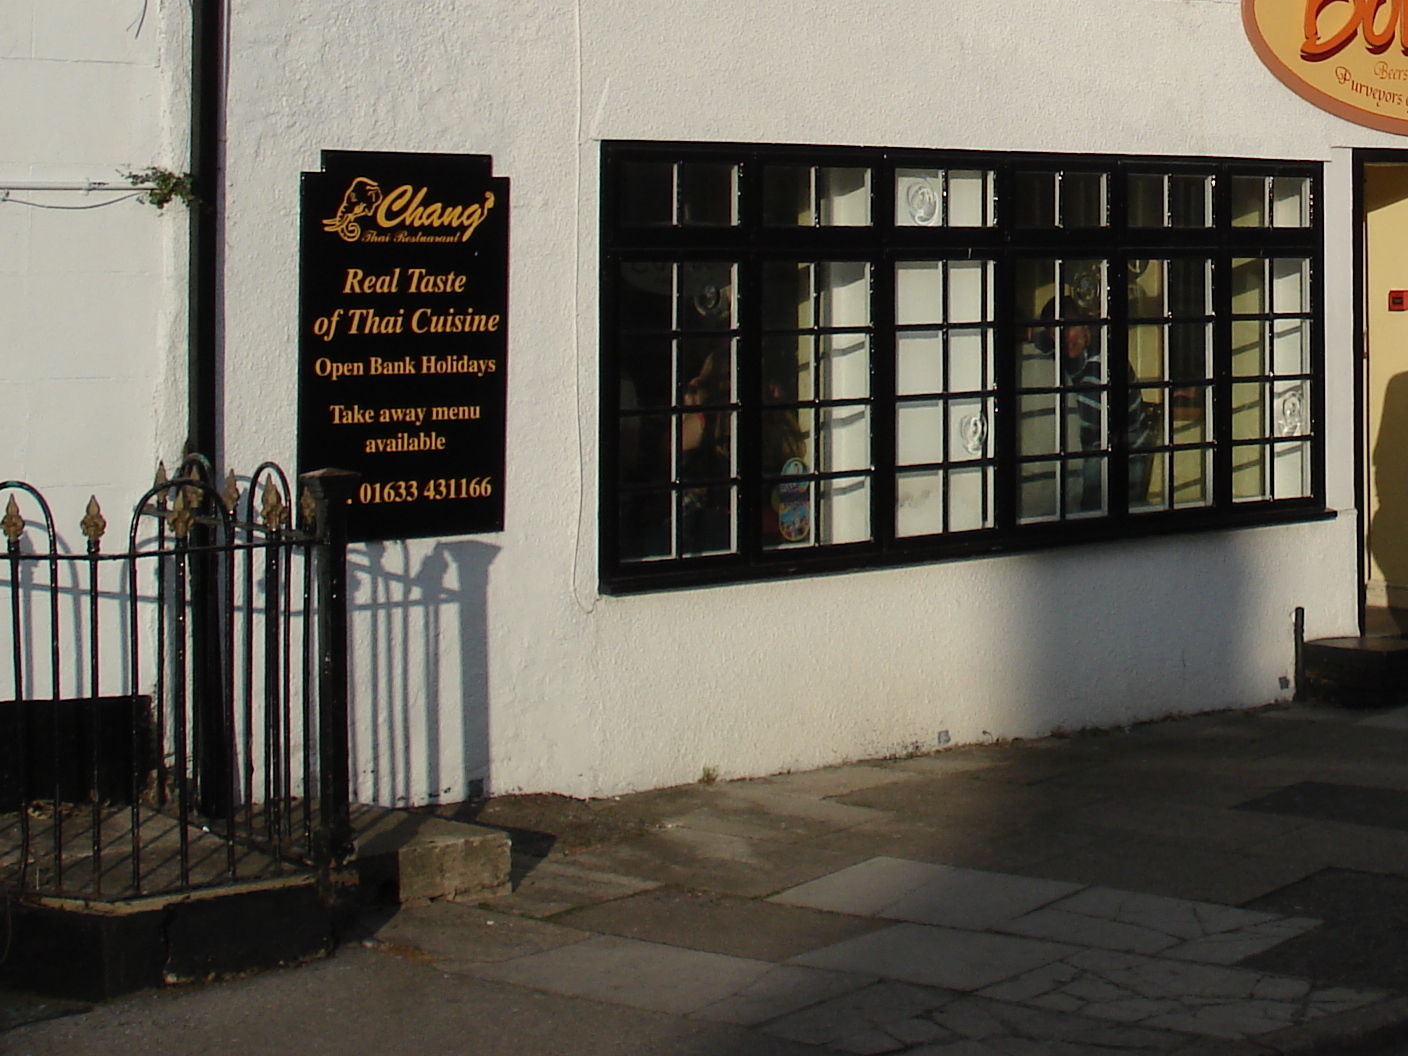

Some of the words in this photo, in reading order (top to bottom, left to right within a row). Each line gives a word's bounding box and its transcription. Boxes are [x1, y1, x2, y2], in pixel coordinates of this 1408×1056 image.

[1373, 61, 1408, 81] Beers
[1335, 66, 1403, 108] Purveyors
[376, 184, 495, 242] Chang
[361, 229, 390, 243] Thai
[343, 269, 399, 294] Real
[407, 268, 467, 293] Taste
[313, 309, 344, 341] of
[347, 309, 404, 335] Thai
[411, 307, 500, 334] Cuisine
[315, 357, 364, 380] Open
[369, 356, 416, 375] Bank
[421, 354, 496, 377] Holidays
[330, 405, 375, 424] Take
[379, 408, 427, 425] away
[431, 406, 481, 421] menu
[365, 433, 446, 454] available
[359, 480, 419, 504] 01633
[423, 476, 492, 501] 431166
